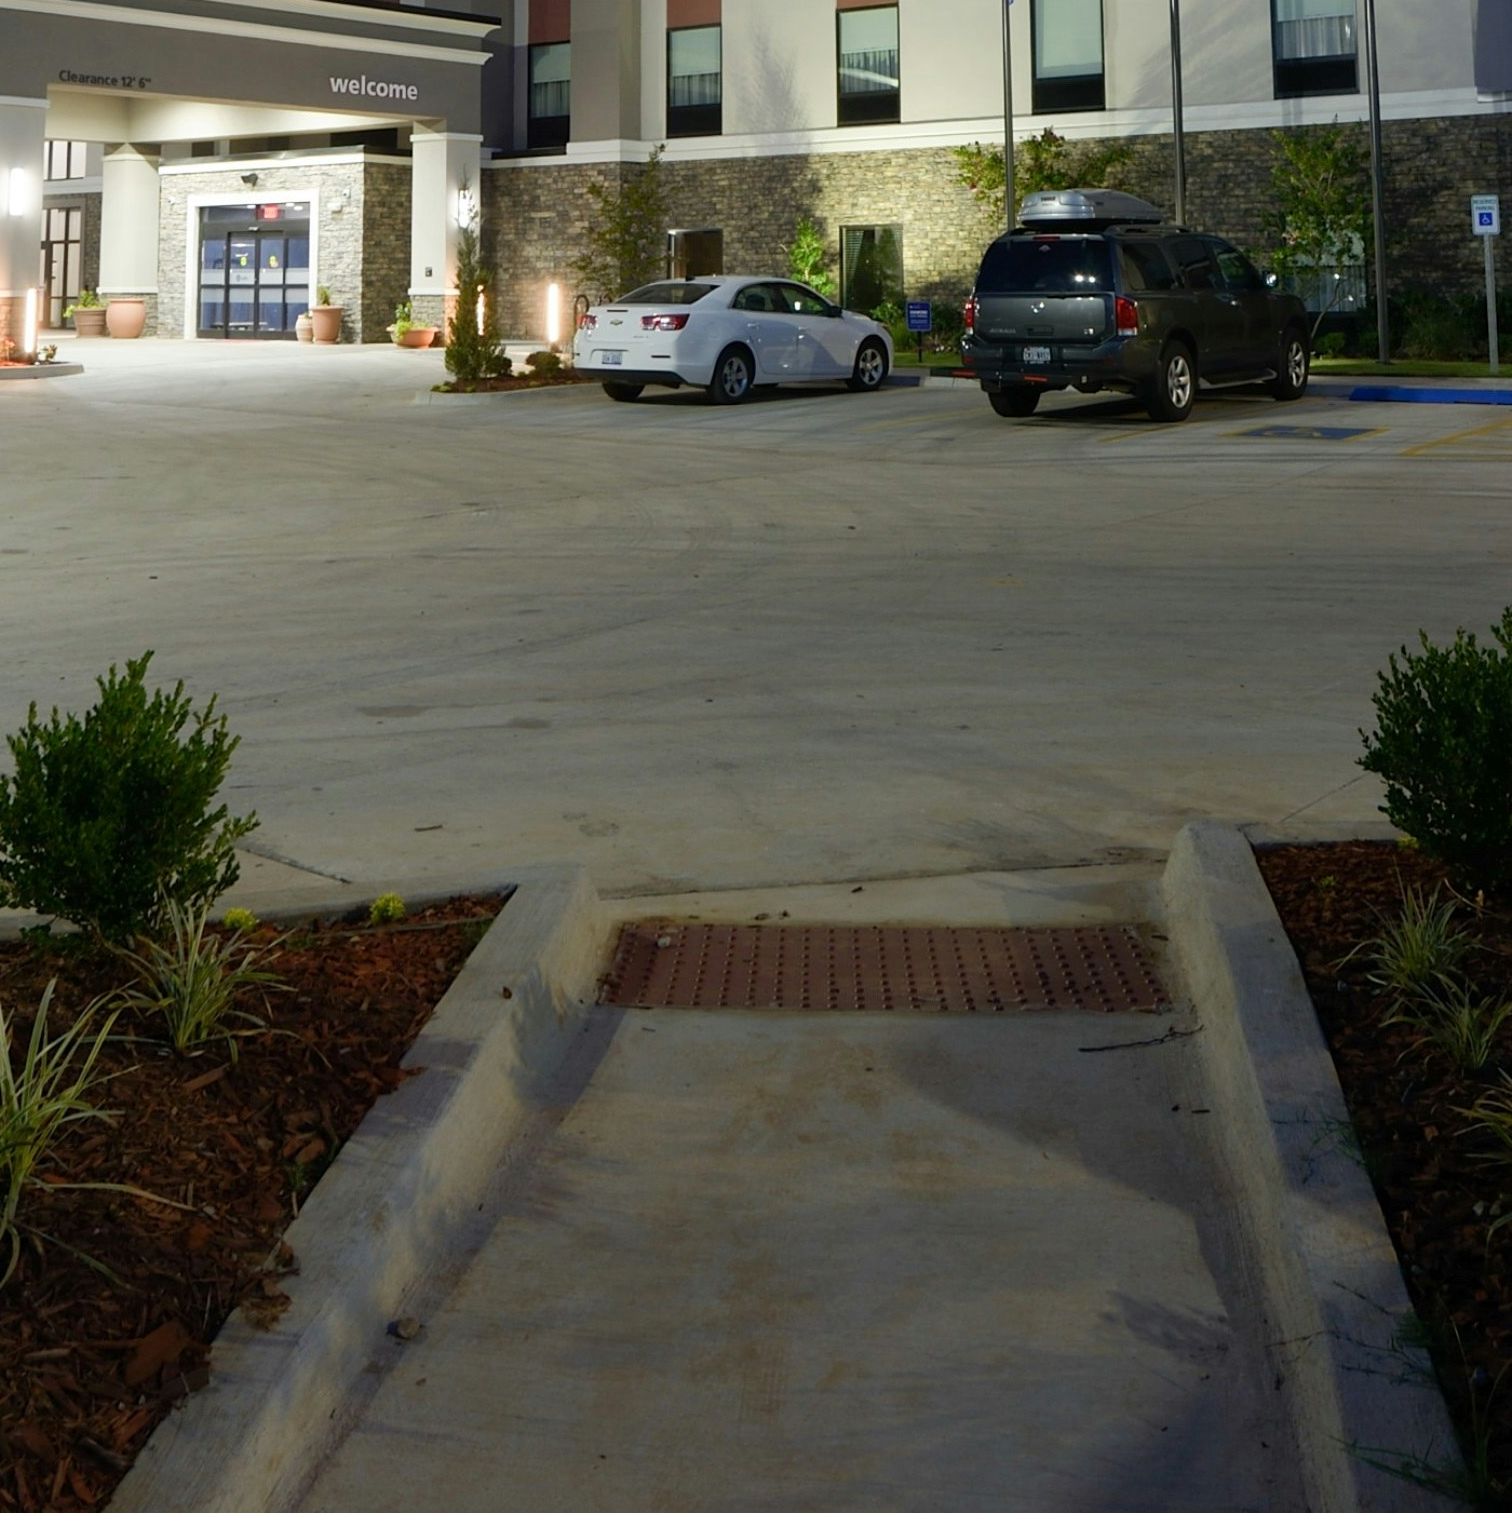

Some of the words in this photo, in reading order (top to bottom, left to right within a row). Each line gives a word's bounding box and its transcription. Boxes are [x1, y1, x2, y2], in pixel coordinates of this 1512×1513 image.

[58, 69, 119, 86] Clearance
[120, 75, 137, 88] 12'
[329, 74, 419, 101] welcome
